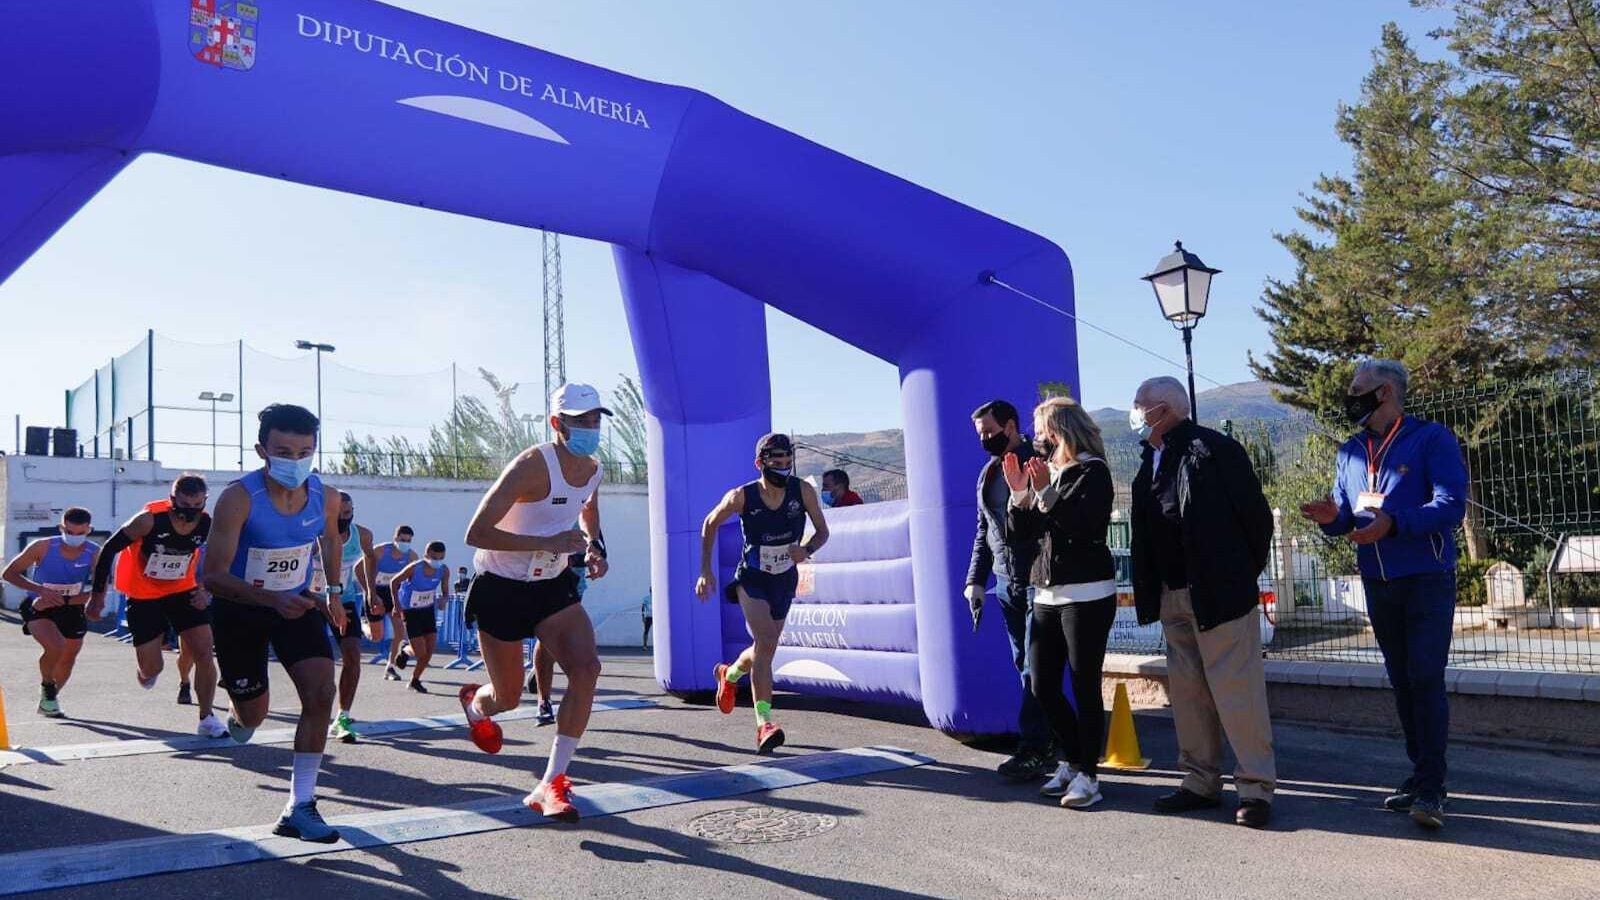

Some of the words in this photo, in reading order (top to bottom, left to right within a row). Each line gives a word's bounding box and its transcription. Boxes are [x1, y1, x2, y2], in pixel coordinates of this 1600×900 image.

[296, 14, 489, 85] DIPUTACIÓN
[498, 70, 533, 97] DE
[540, 83, 650, 129] ALMERÍA
[160, 562, 181, 570] 149
[266, 558, 300, 574] 290
[787, 606, 848, 627] UTACIÓN
